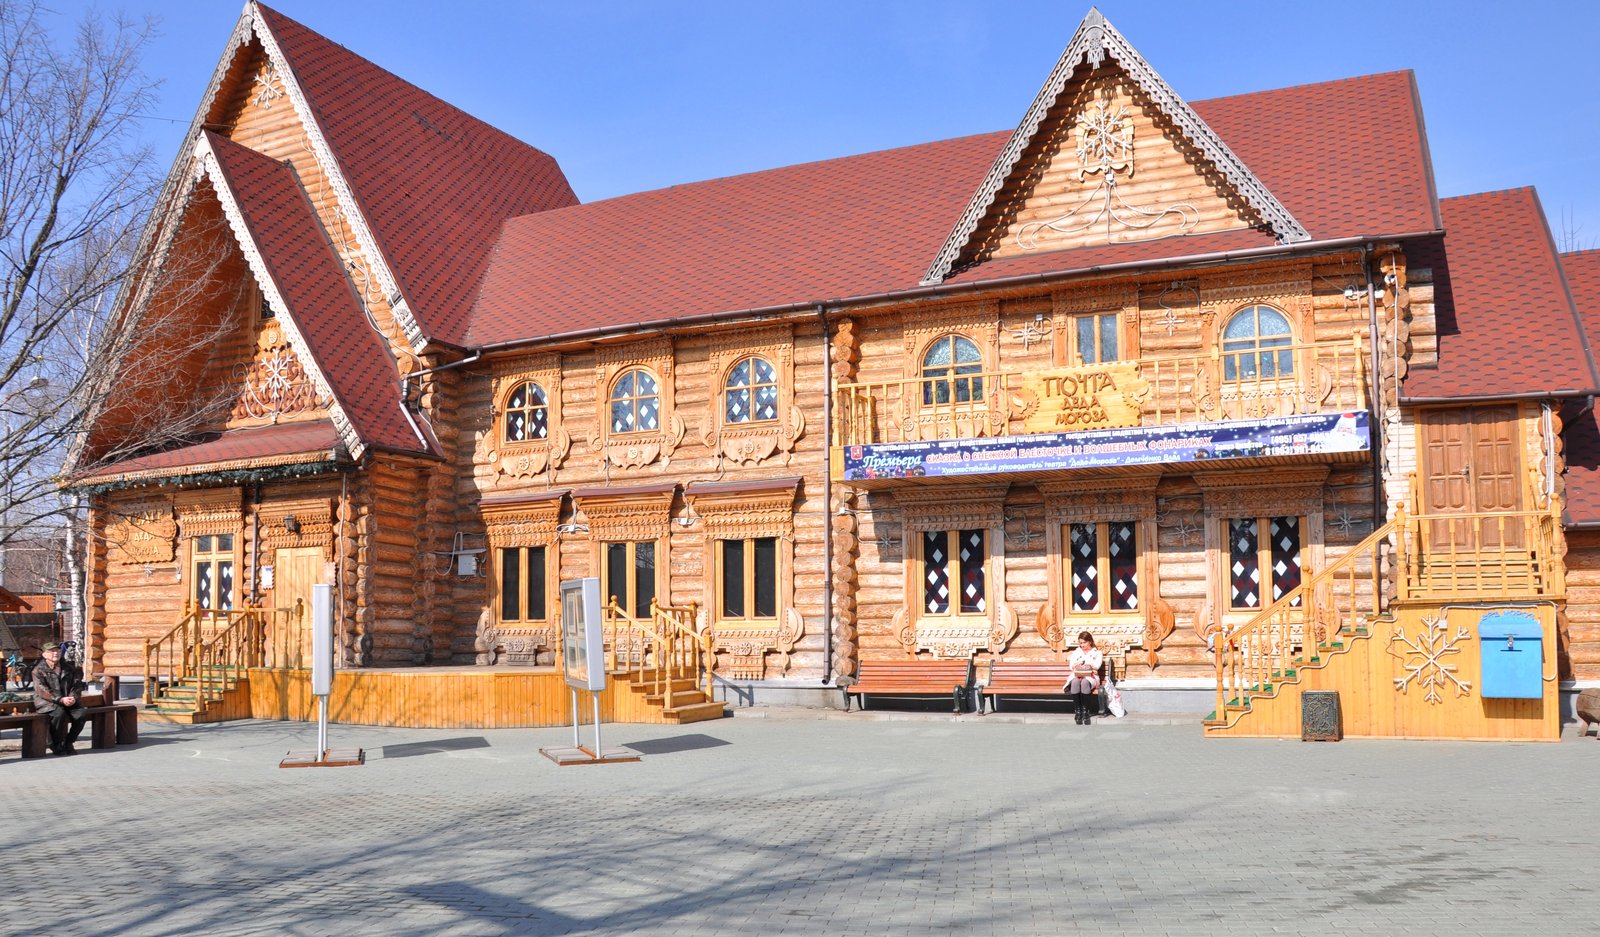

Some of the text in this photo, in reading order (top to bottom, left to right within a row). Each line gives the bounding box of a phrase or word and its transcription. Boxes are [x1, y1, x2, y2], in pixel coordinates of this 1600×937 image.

[1043, 371, 1117, 398] ПОЧТА
[1062, 395, 1101, 411] ДЕДА
[1055, 409, 1110, 426] МОРОЗА
[926, 453, 962, 464] СКАЗКА
[972, 447, 1018, 461] СНЕЖНОЙ
[1074, 444, 1083, 456] И
[1083, 441, 1148, 455] ВОЛШЕБНЫХ
[1148, 435, 1213, 450] ФОНАРИКАХ
[862, 455, 922, 471] Премьера
